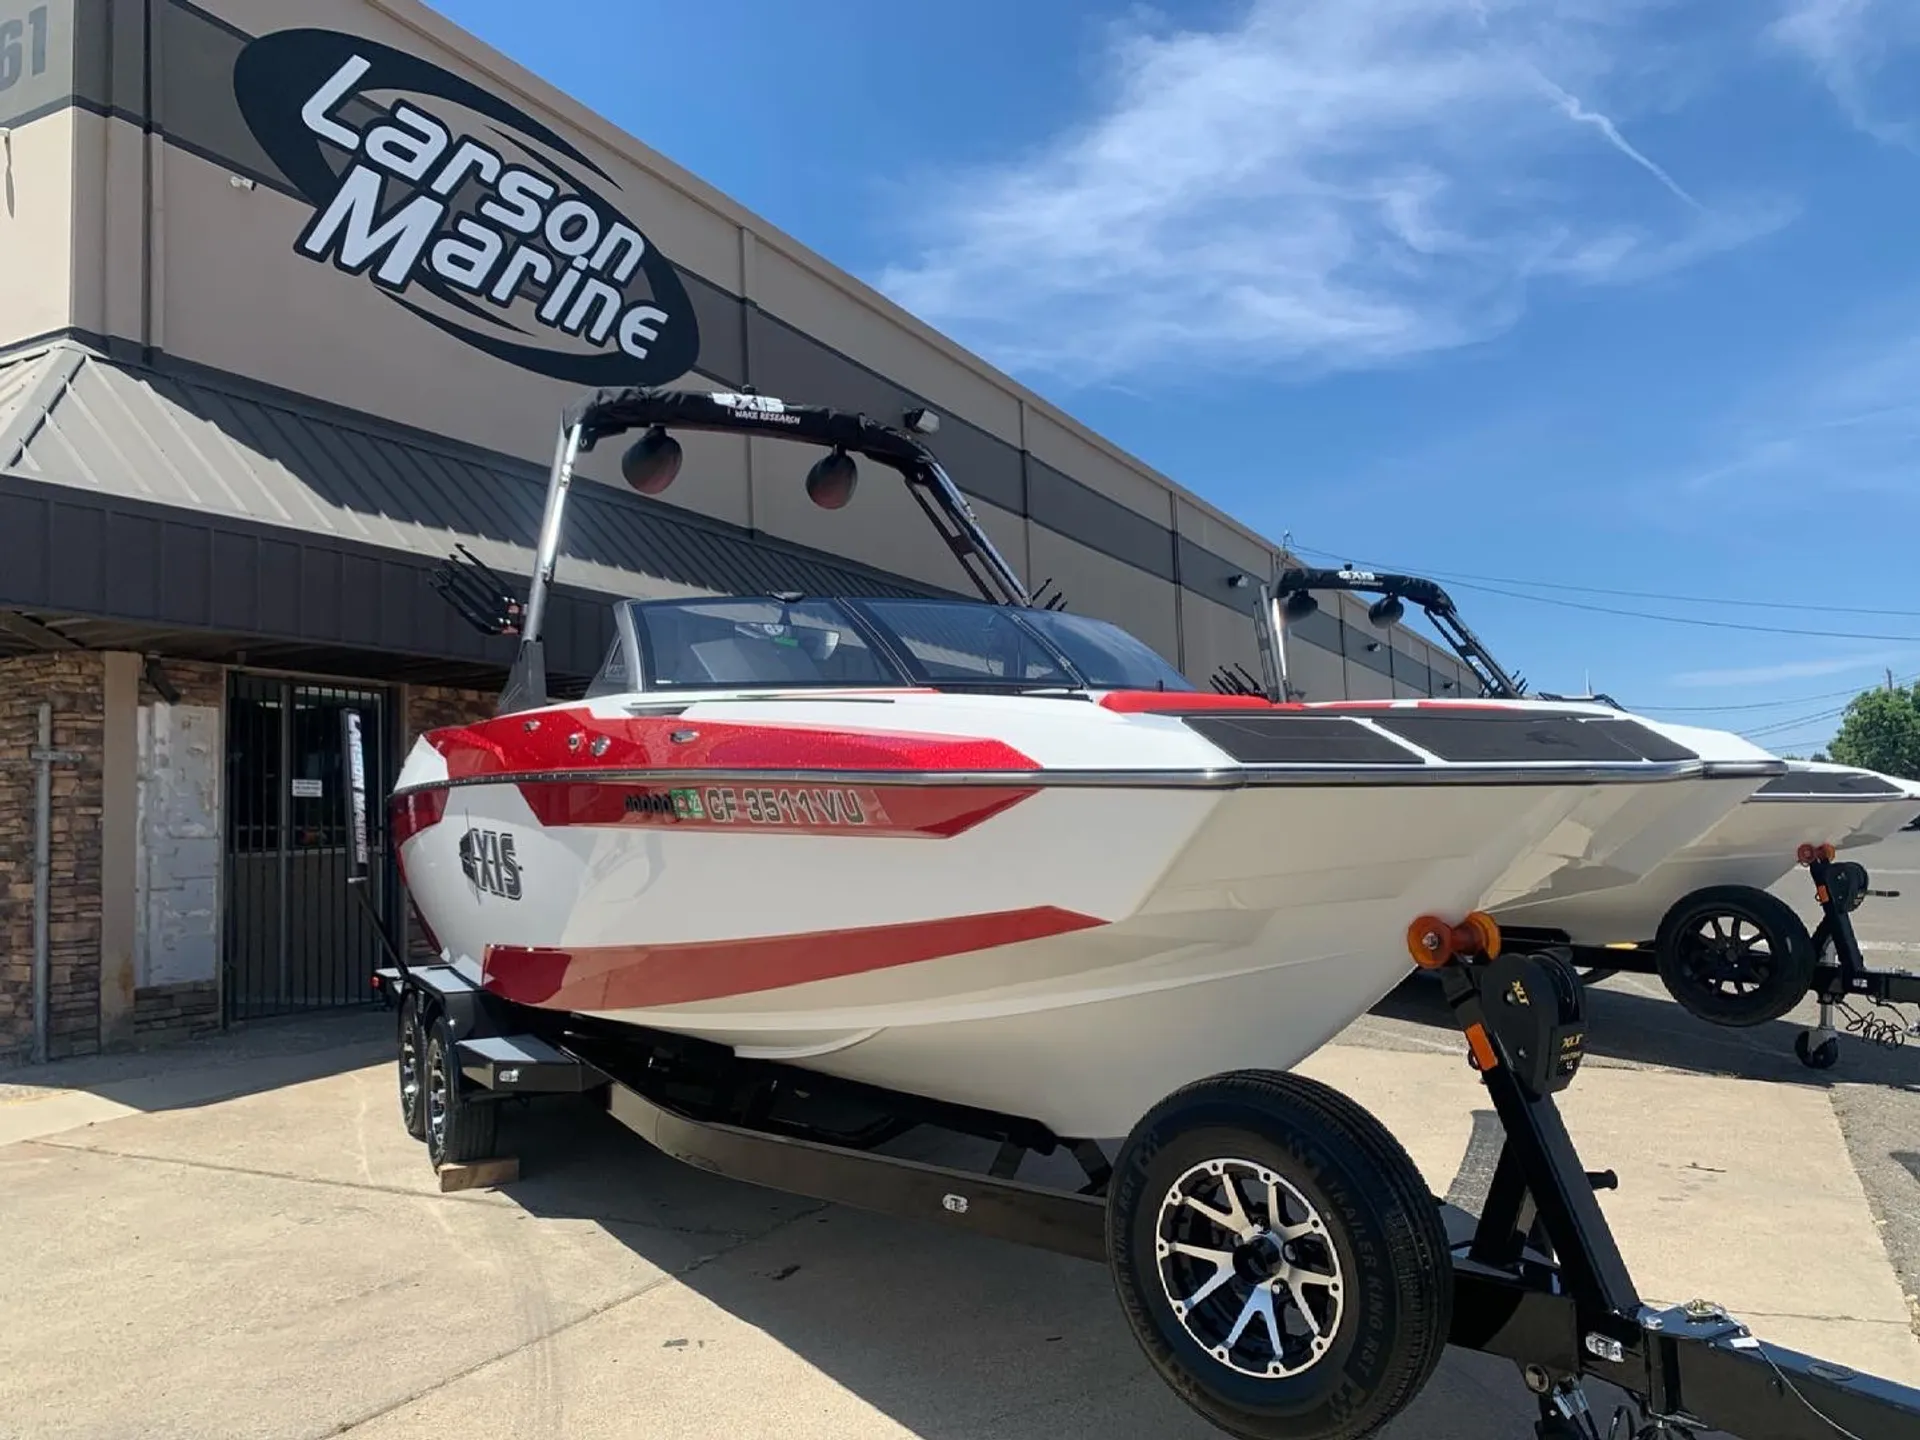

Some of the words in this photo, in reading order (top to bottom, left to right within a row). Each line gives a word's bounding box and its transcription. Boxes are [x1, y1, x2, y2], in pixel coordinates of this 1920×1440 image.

[301, 54, 645, 283] Larson
[304, 164, 669, 360] Marine
[734, 410, 758, 420] WAKE
[760, 412, 800, 425] RESEARCH
[705, 787, 737, 823] CF
[743, 788, 817, 823] 3511
[812, 788, 866, 825] VU
[1326, 1177, 1379, 1268] TRAILER
[1366, 1274, 1383, 1332] KING
